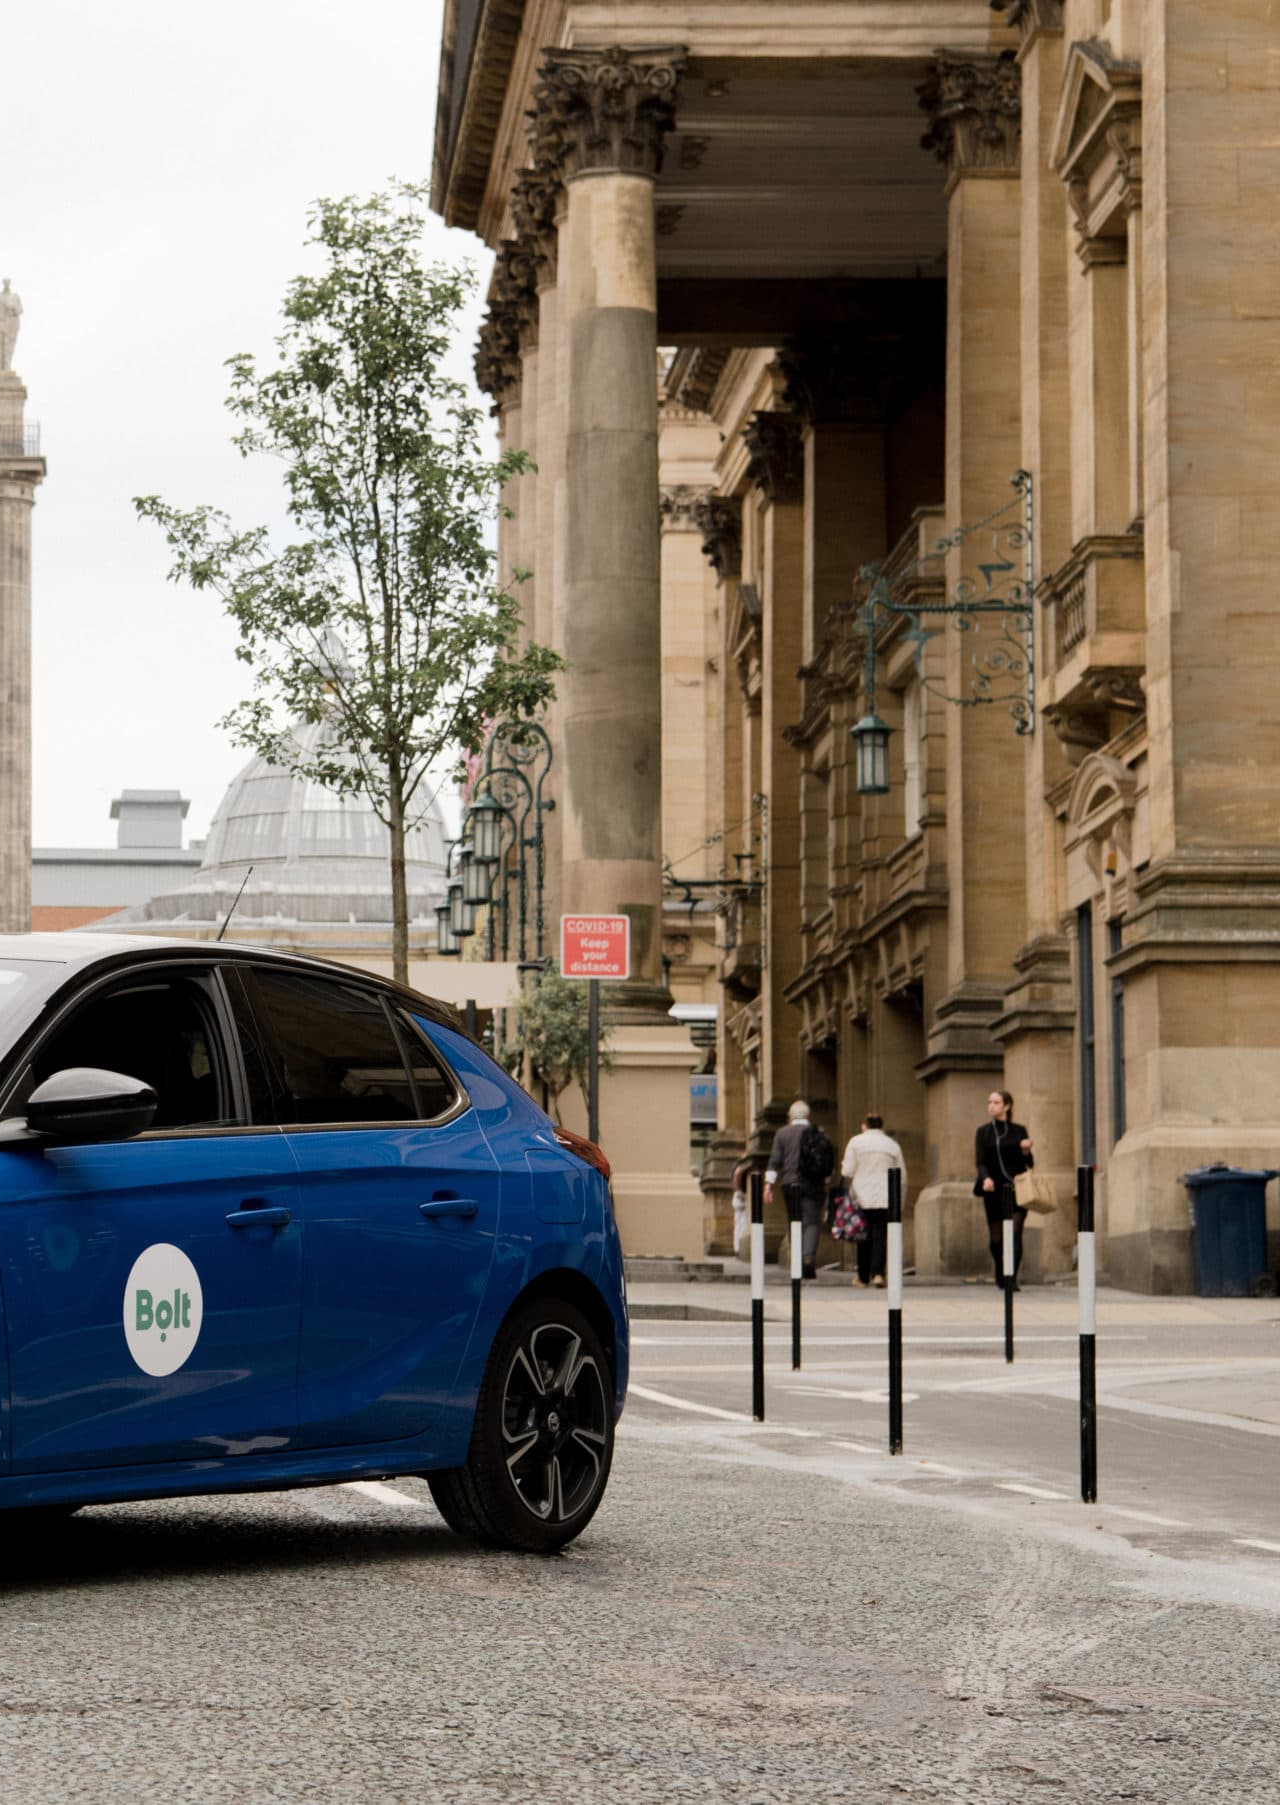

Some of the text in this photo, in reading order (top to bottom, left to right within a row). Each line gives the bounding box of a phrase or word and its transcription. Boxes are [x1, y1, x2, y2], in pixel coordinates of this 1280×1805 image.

[567, 920, 624, 934] COVID-19
[581, 938, 608, 950] Keep
[583, 951, 607, 962] your
[570, 961, 619, 973] distance
[135, 1287, 191, 1343] Bolt
